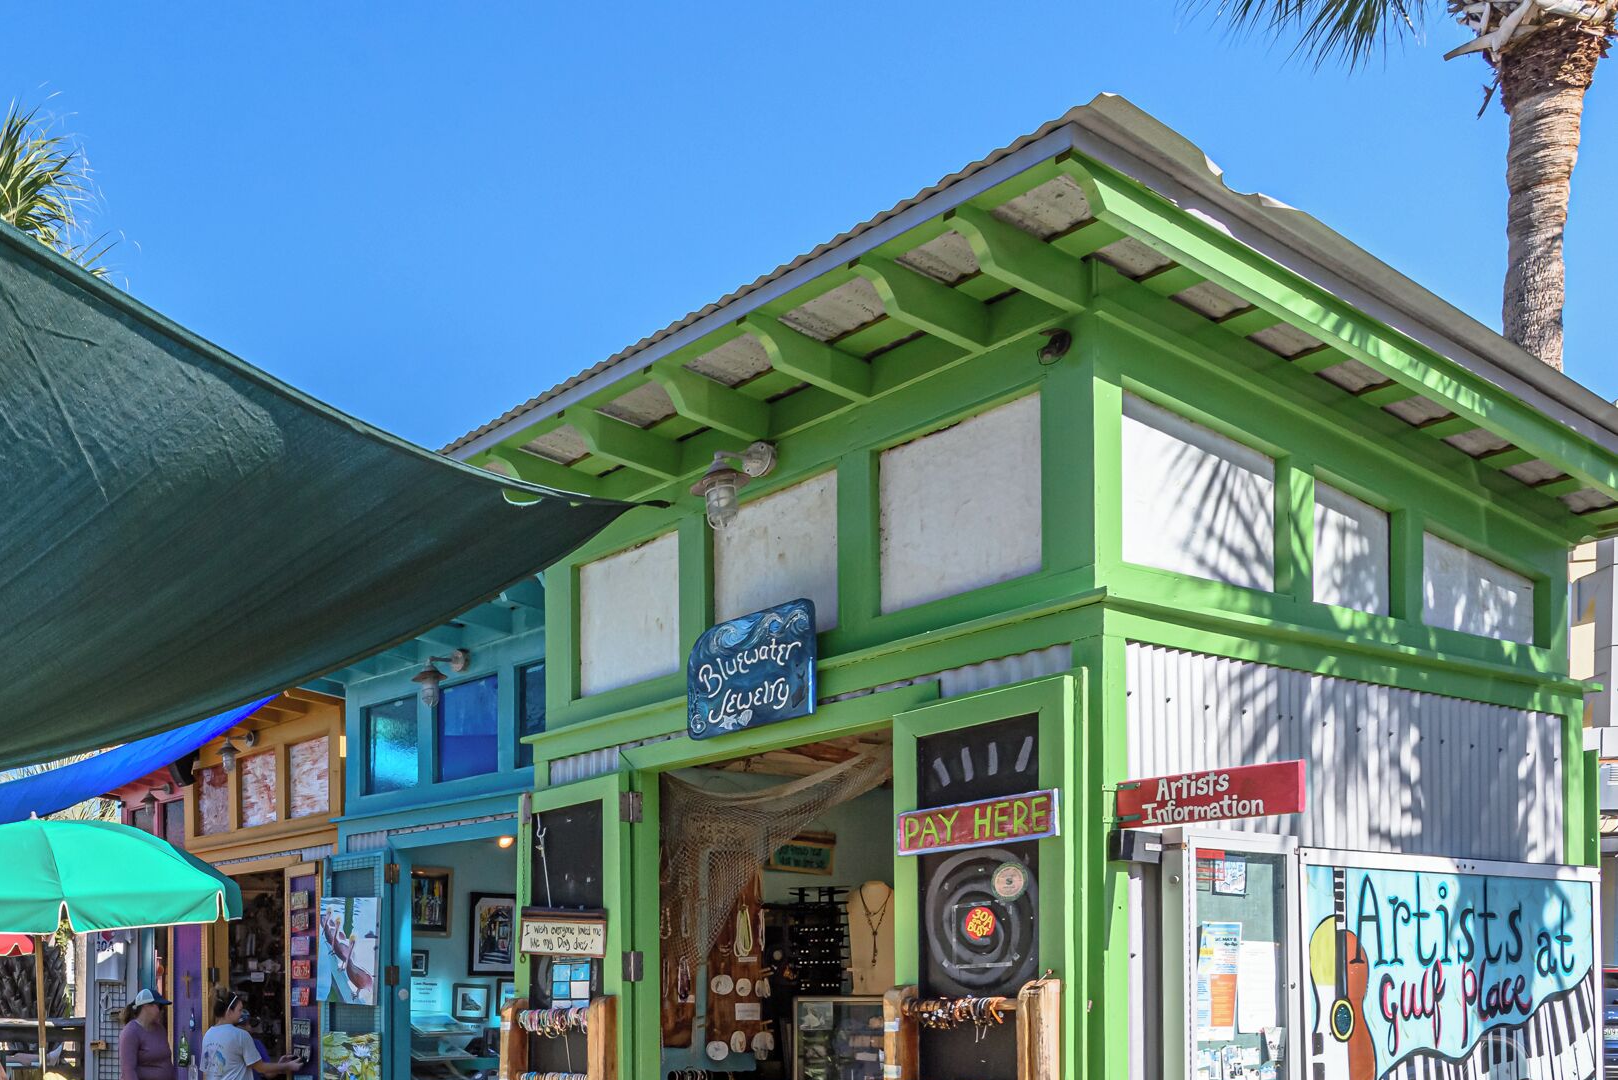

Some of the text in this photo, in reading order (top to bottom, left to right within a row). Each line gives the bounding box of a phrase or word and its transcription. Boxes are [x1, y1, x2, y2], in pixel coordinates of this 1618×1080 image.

[698, 638, 802, 699] Bluewater
[708, 677, 790, 724] Jewelry
[1155, 771, 1230, 802] Artists
[903, 796, 1049, 849] PAY HERE
[1141, 795, 1265, 825] Information
[524, 924, 530, 936] I
[577, 926, 591, 936] loved
[593, 928, 602, 937] me
[967, 922, 989, 936] BUST
[972, 909, 993, 928] 30A
[1349, 872, 1576, 978] Artists at
[557, 936, 571, 951] Dog
[1379, 958, 1534, 1057] gulf place
